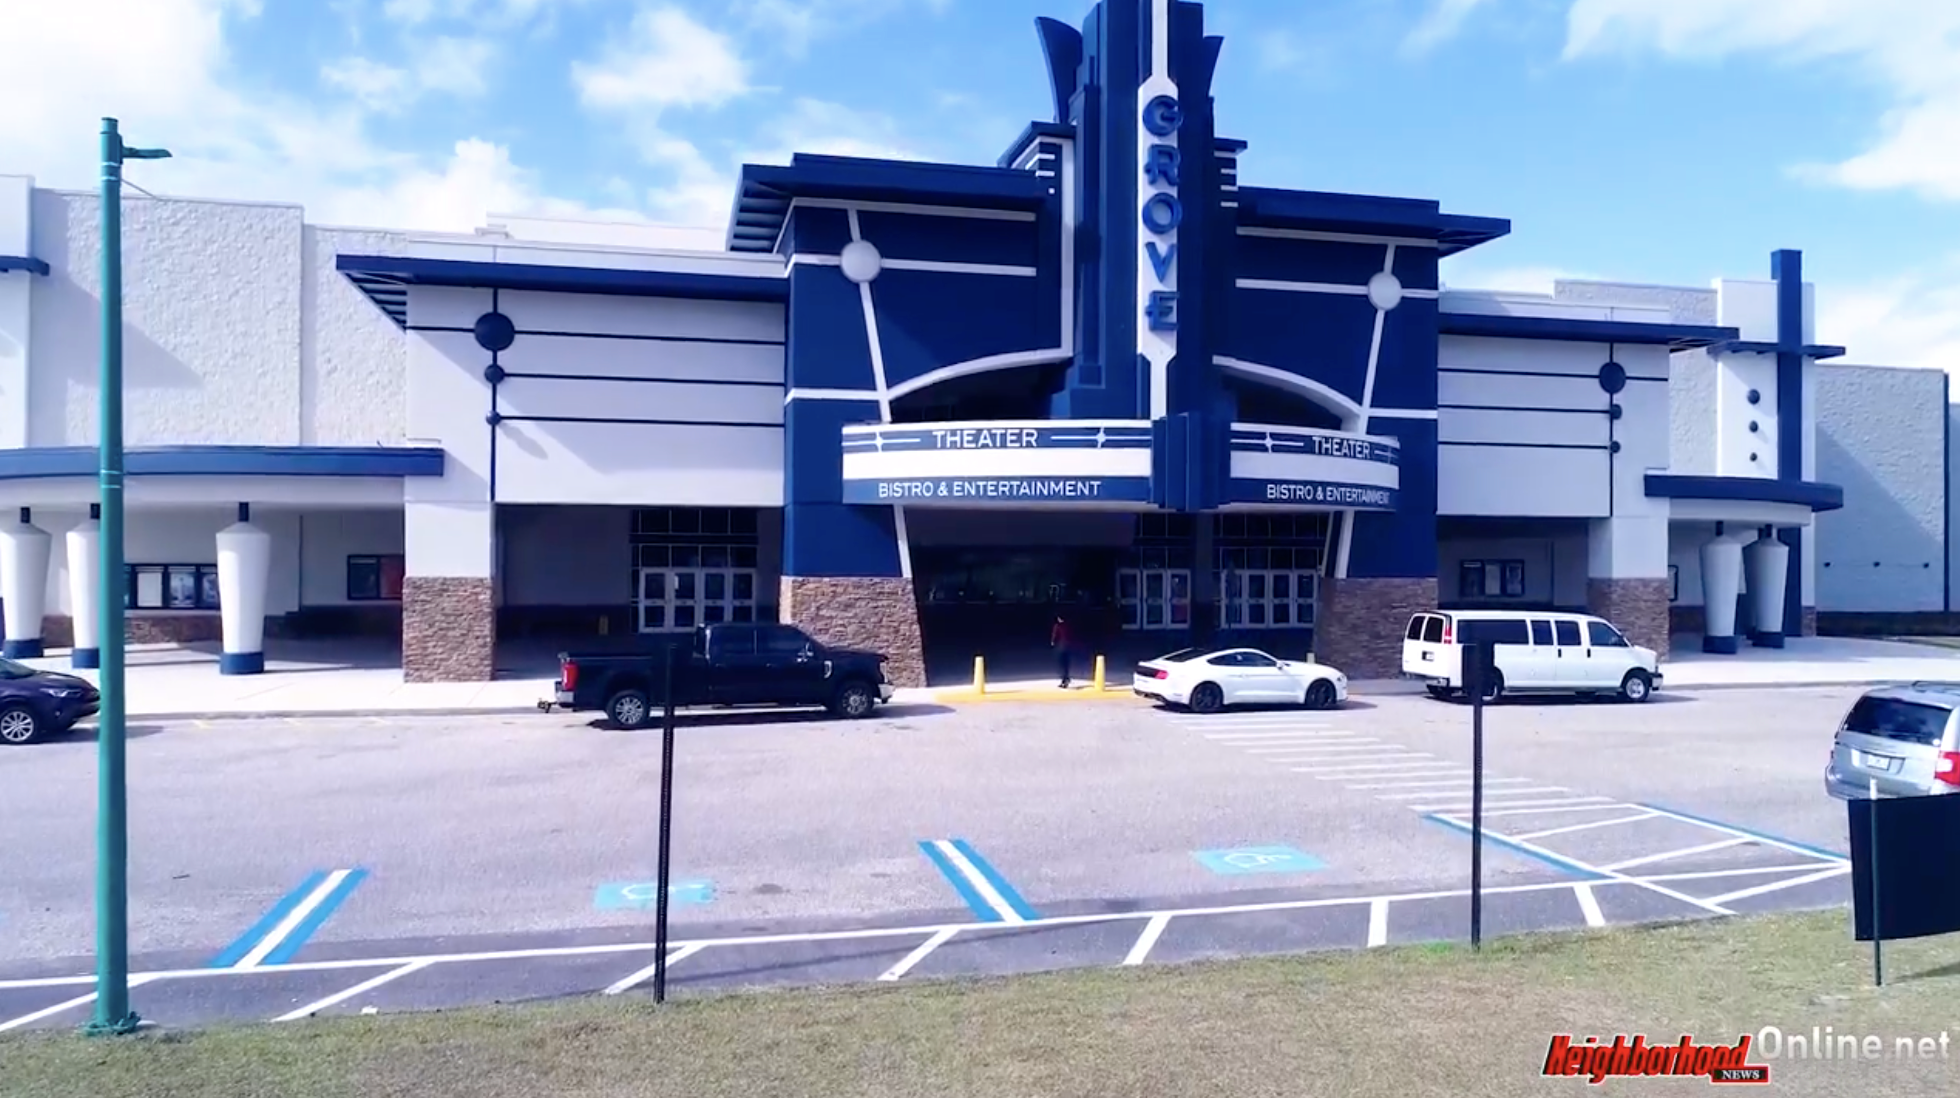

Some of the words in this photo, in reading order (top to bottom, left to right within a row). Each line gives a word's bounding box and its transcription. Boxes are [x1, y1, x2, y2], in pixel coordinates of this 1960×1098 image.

[1142, 95, 1182, 331] GROVE
[932, 429, 1038, 448] THEATER
[1312, 436, 1371, 459] THEATER
[878, 481, 934, 498] BISTRO
[937, 481, 949, 496] &
[953, 481, 1101, 496] ENTERTAINMENT
[1267, 484, 1314, 500] BISTRO
[1315, 486, 1324, 500] &
